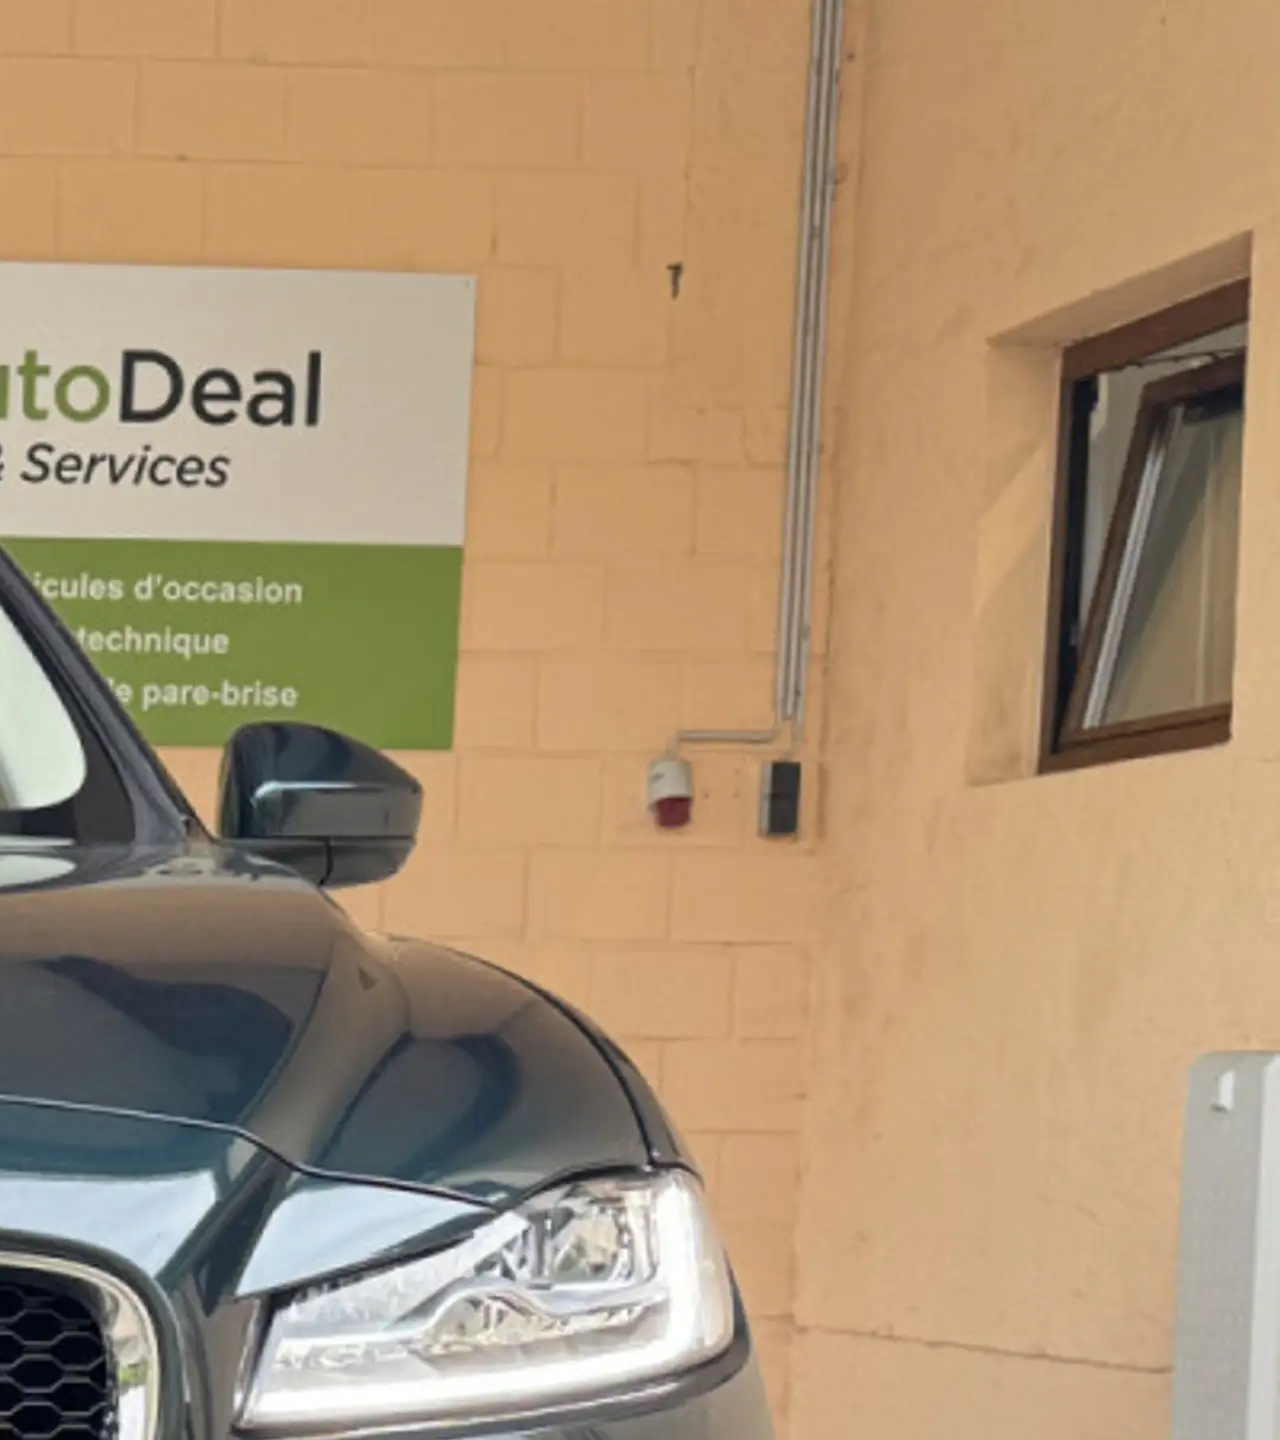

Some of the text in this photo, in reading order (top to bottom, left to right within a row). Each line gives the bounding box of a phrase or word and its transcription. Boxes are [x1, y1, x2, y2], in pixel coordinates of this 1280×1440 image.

[20, 443, 231, 488] Services
[134, 573, 303, 604] d'occasion
[106, 679, 299, 712] e pare-brise
